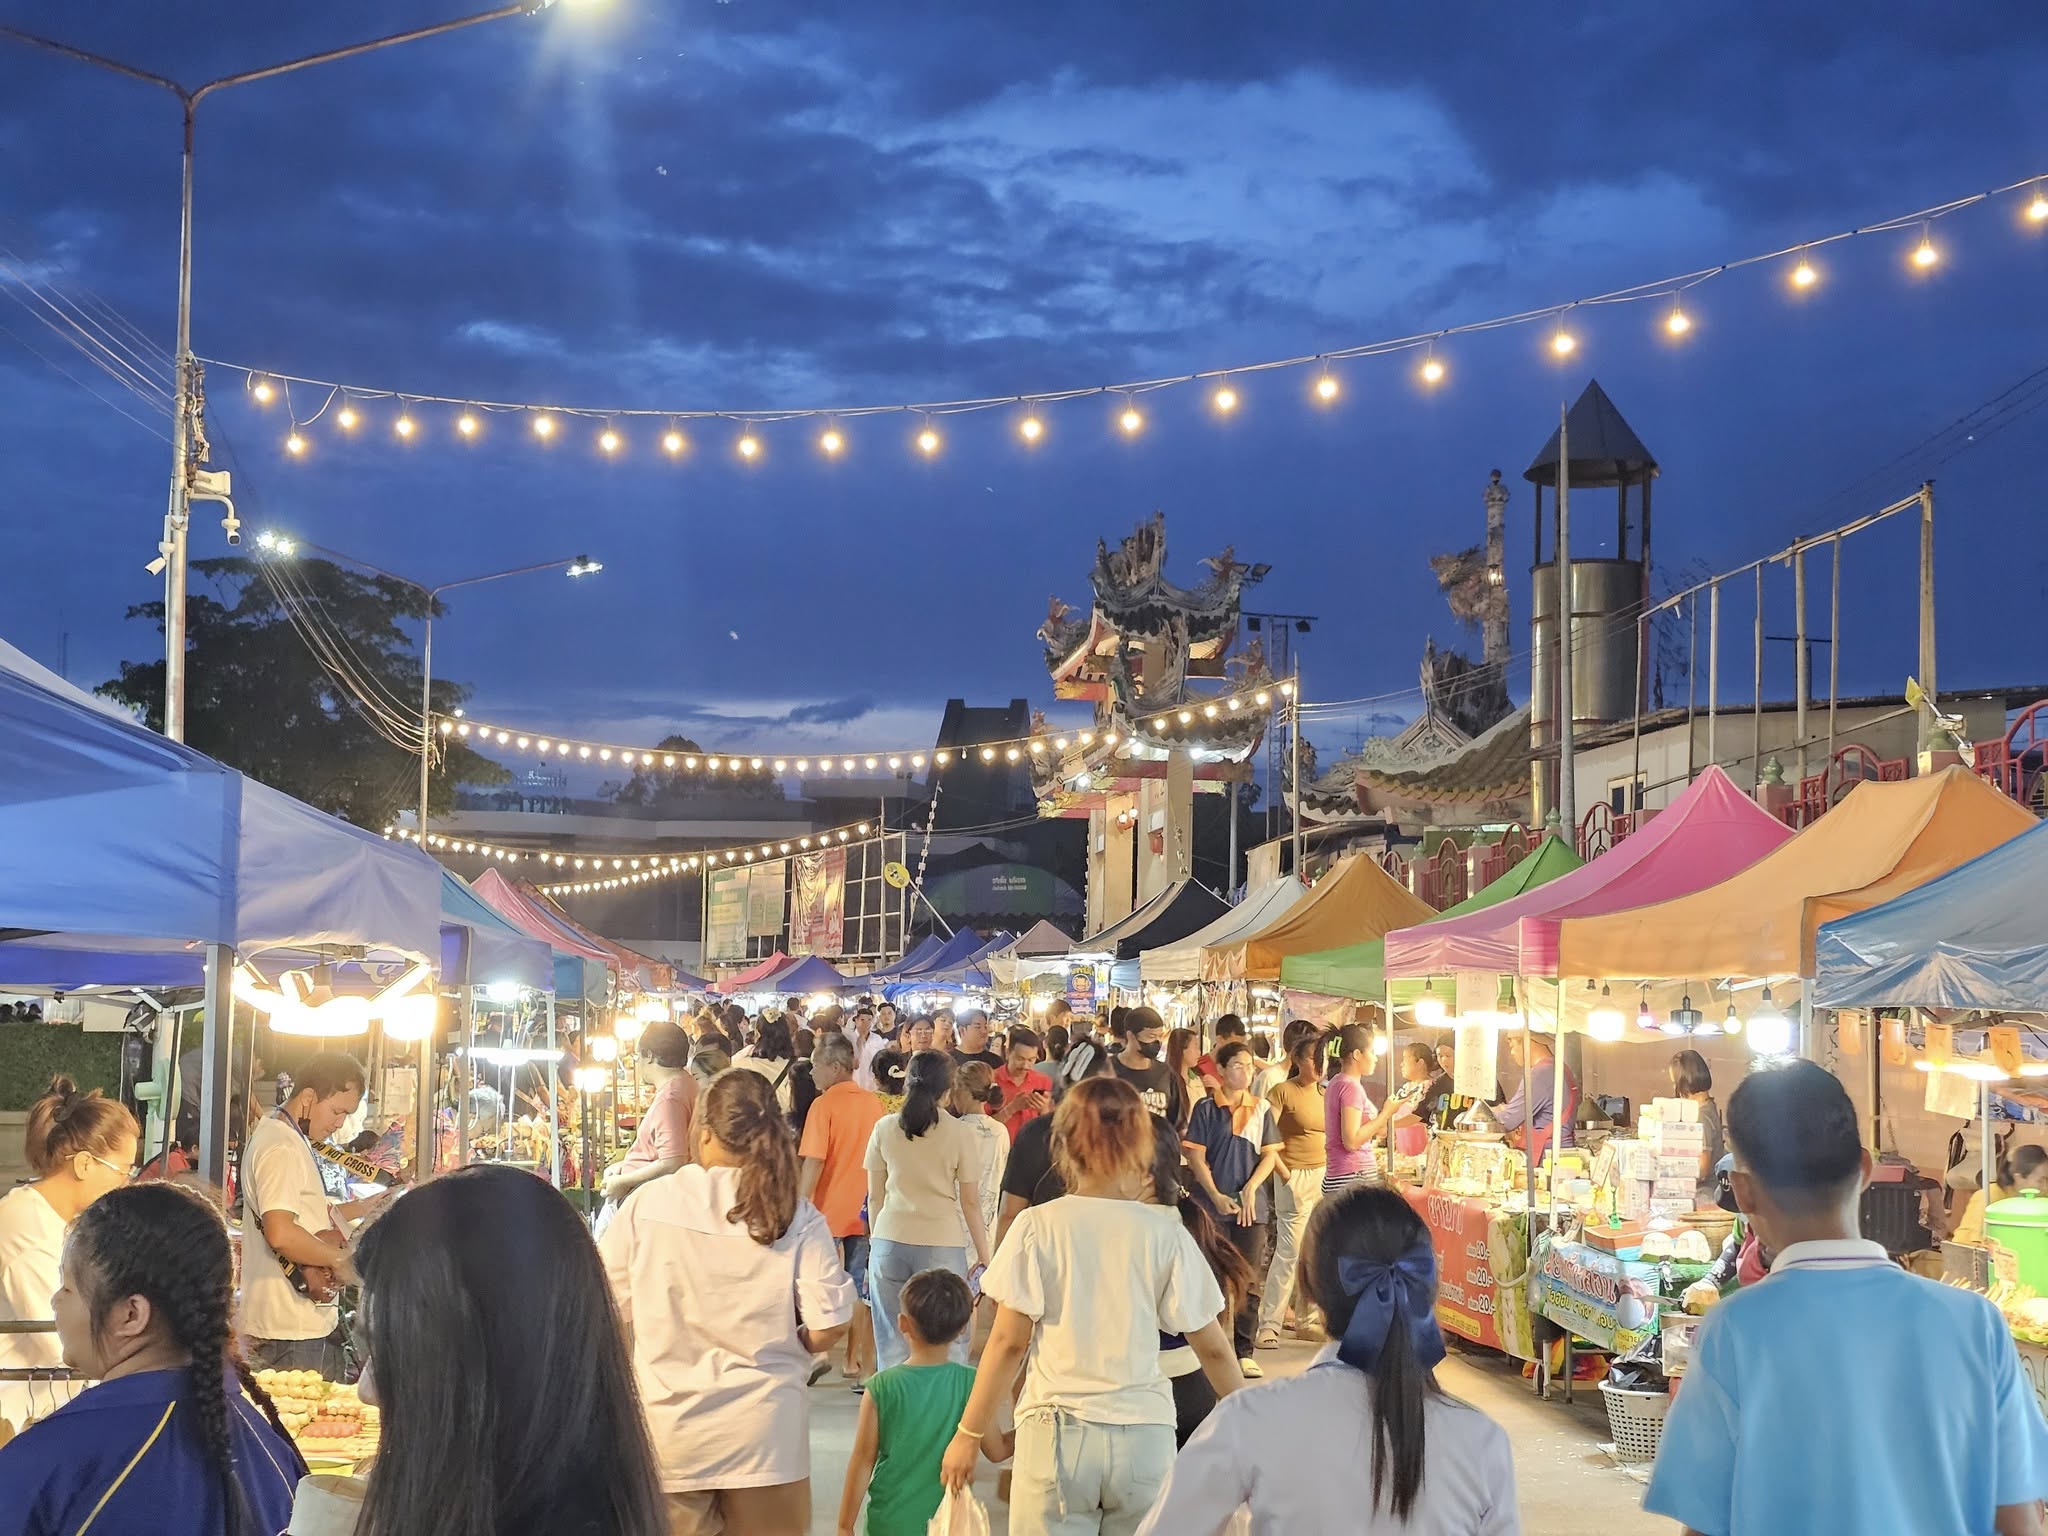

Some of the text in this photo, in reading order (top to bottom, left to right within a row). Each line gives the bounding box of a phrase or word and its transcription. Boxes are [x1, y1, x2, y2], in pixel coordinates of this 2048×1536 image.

[312, 1142, 374, 1176] DO NOT CROSS
